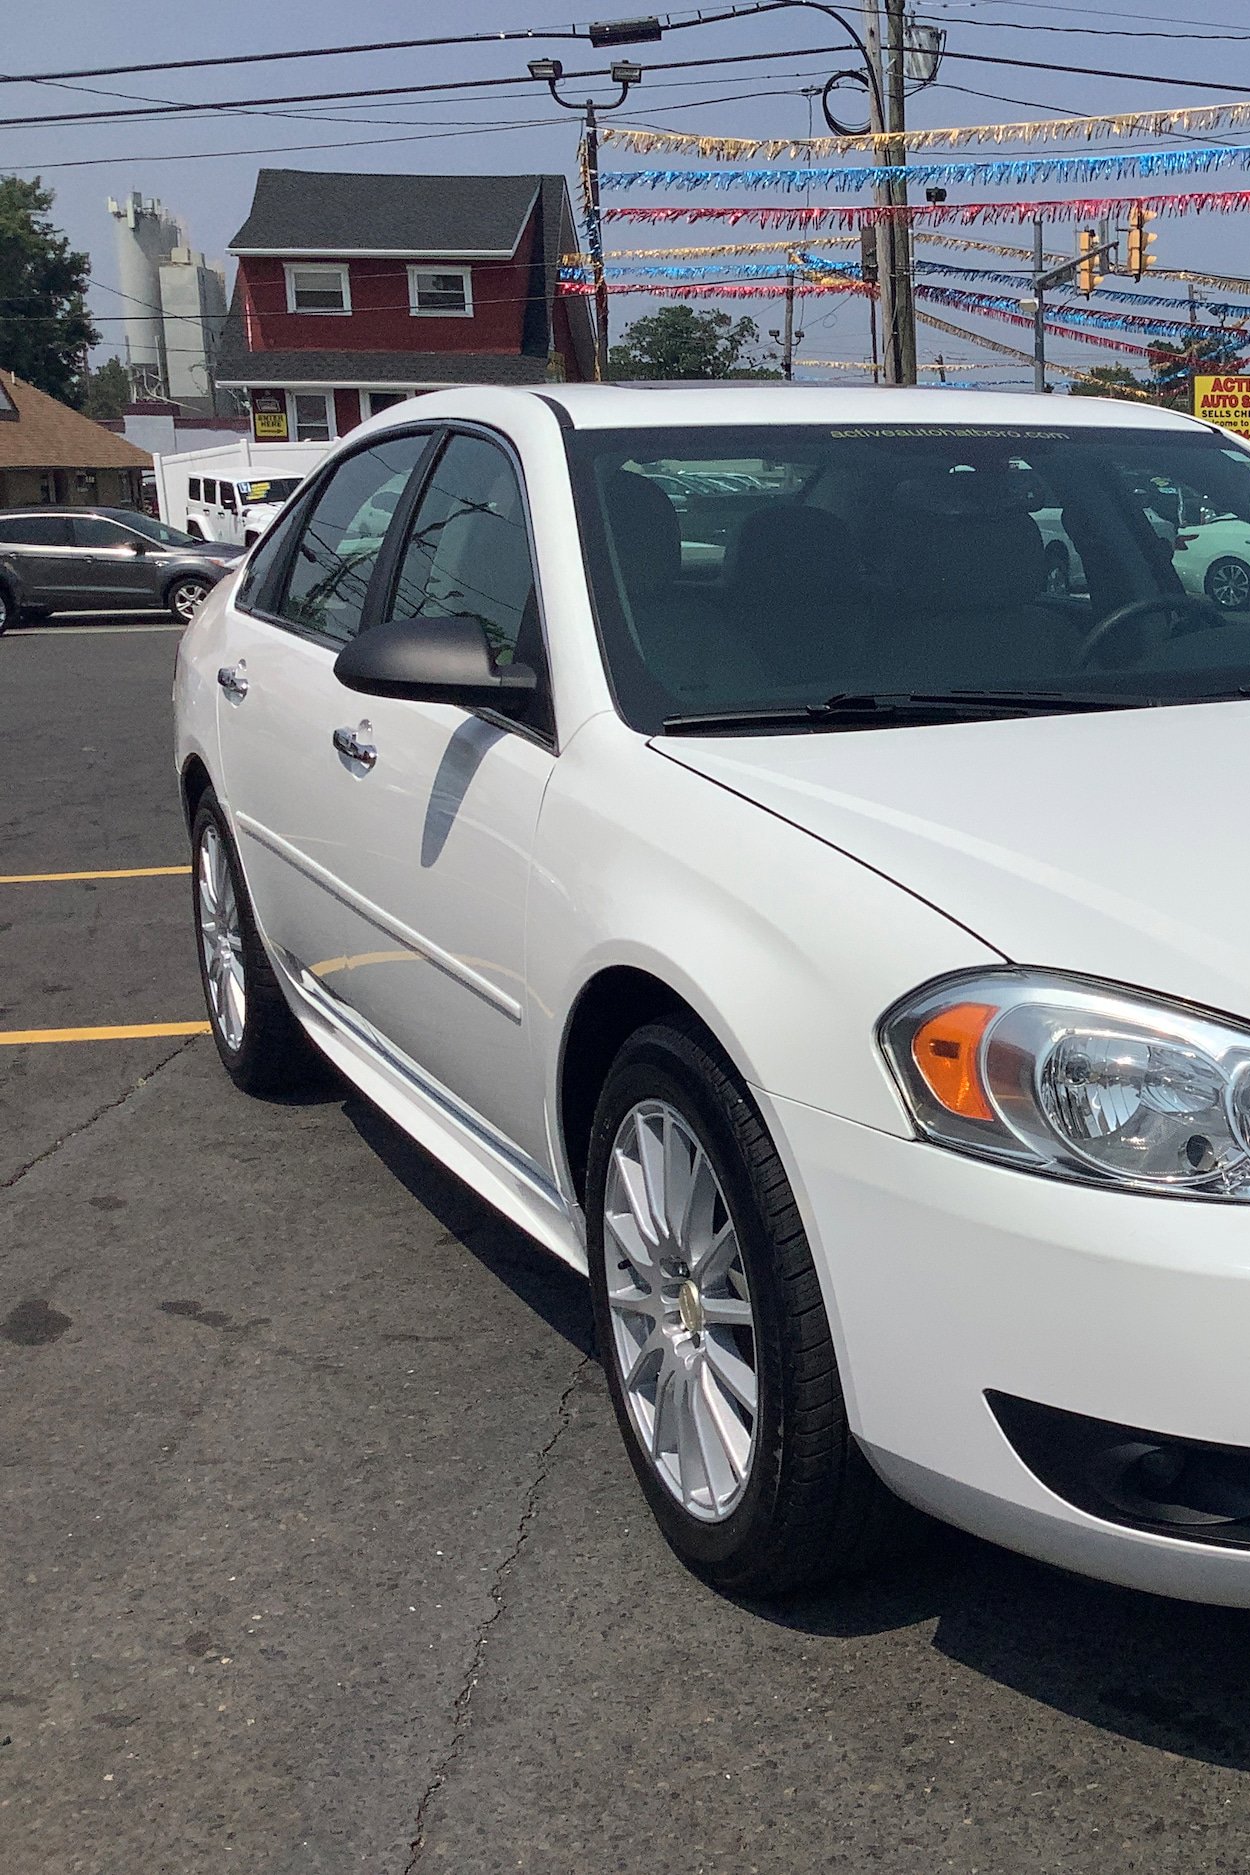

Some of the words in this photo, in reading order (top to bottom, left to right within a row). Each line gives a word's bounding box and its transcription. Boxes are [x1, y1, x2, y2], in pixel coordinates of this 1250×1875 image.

[1201, 394, 1239, 408] AUTO
[1202, 410, 1231, 418] SELLS
[1240, 419, 1249, 427] to
[830, 428, 1070, 440] activeautohatboro.com
